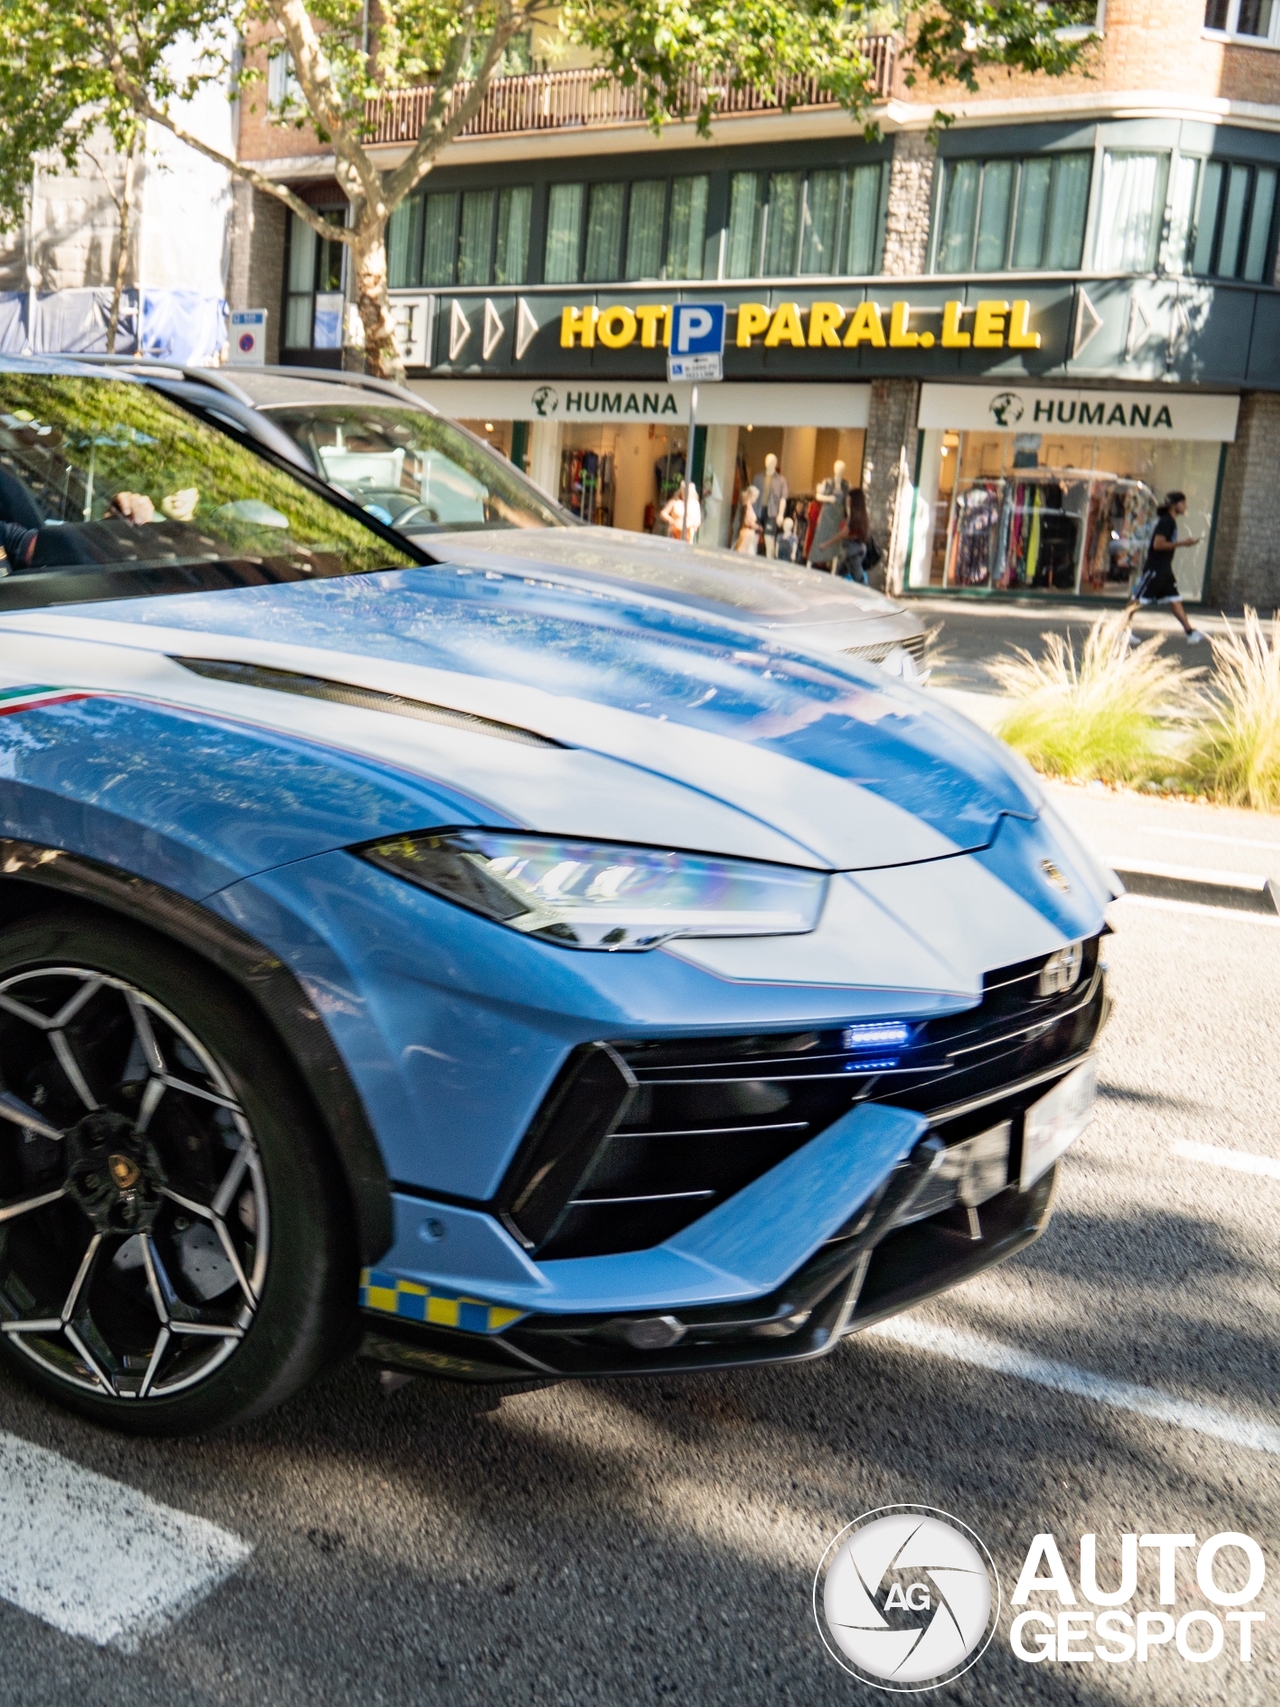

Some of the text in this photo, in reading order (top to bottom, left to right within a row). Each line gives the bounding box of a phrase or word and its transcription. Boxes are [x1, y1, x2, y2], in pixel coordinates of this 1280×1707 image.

[561, 301, 1041, 350] HOT PARAL.LEL
[678, 308, 713, 352] P
[566, 391, 678, 415] HUMANA
[1033, 399, 1174, 429] HUMANA
